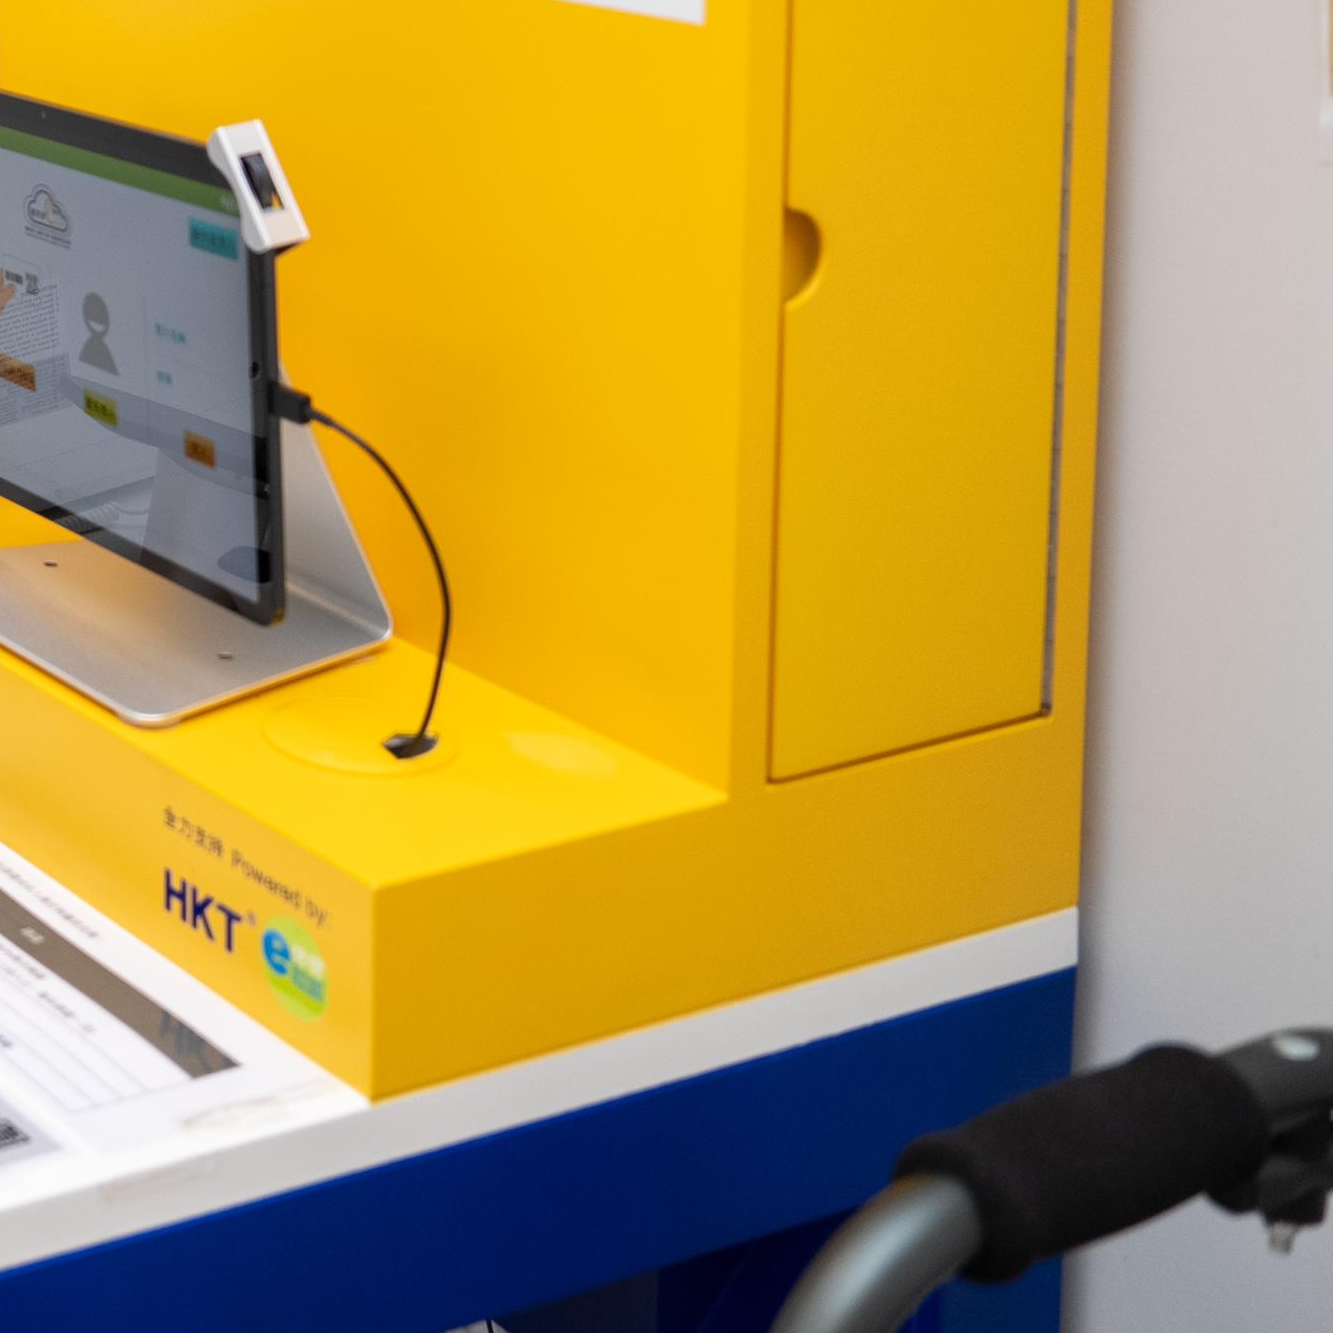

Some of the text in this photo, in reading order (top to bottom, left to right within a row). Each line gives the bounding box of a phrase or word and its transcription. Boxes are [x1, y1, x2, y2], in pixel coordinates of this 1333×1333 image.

[164, 805, 302, 910] 全力支持 Powered
[164, 867, 242, 954] HKT
